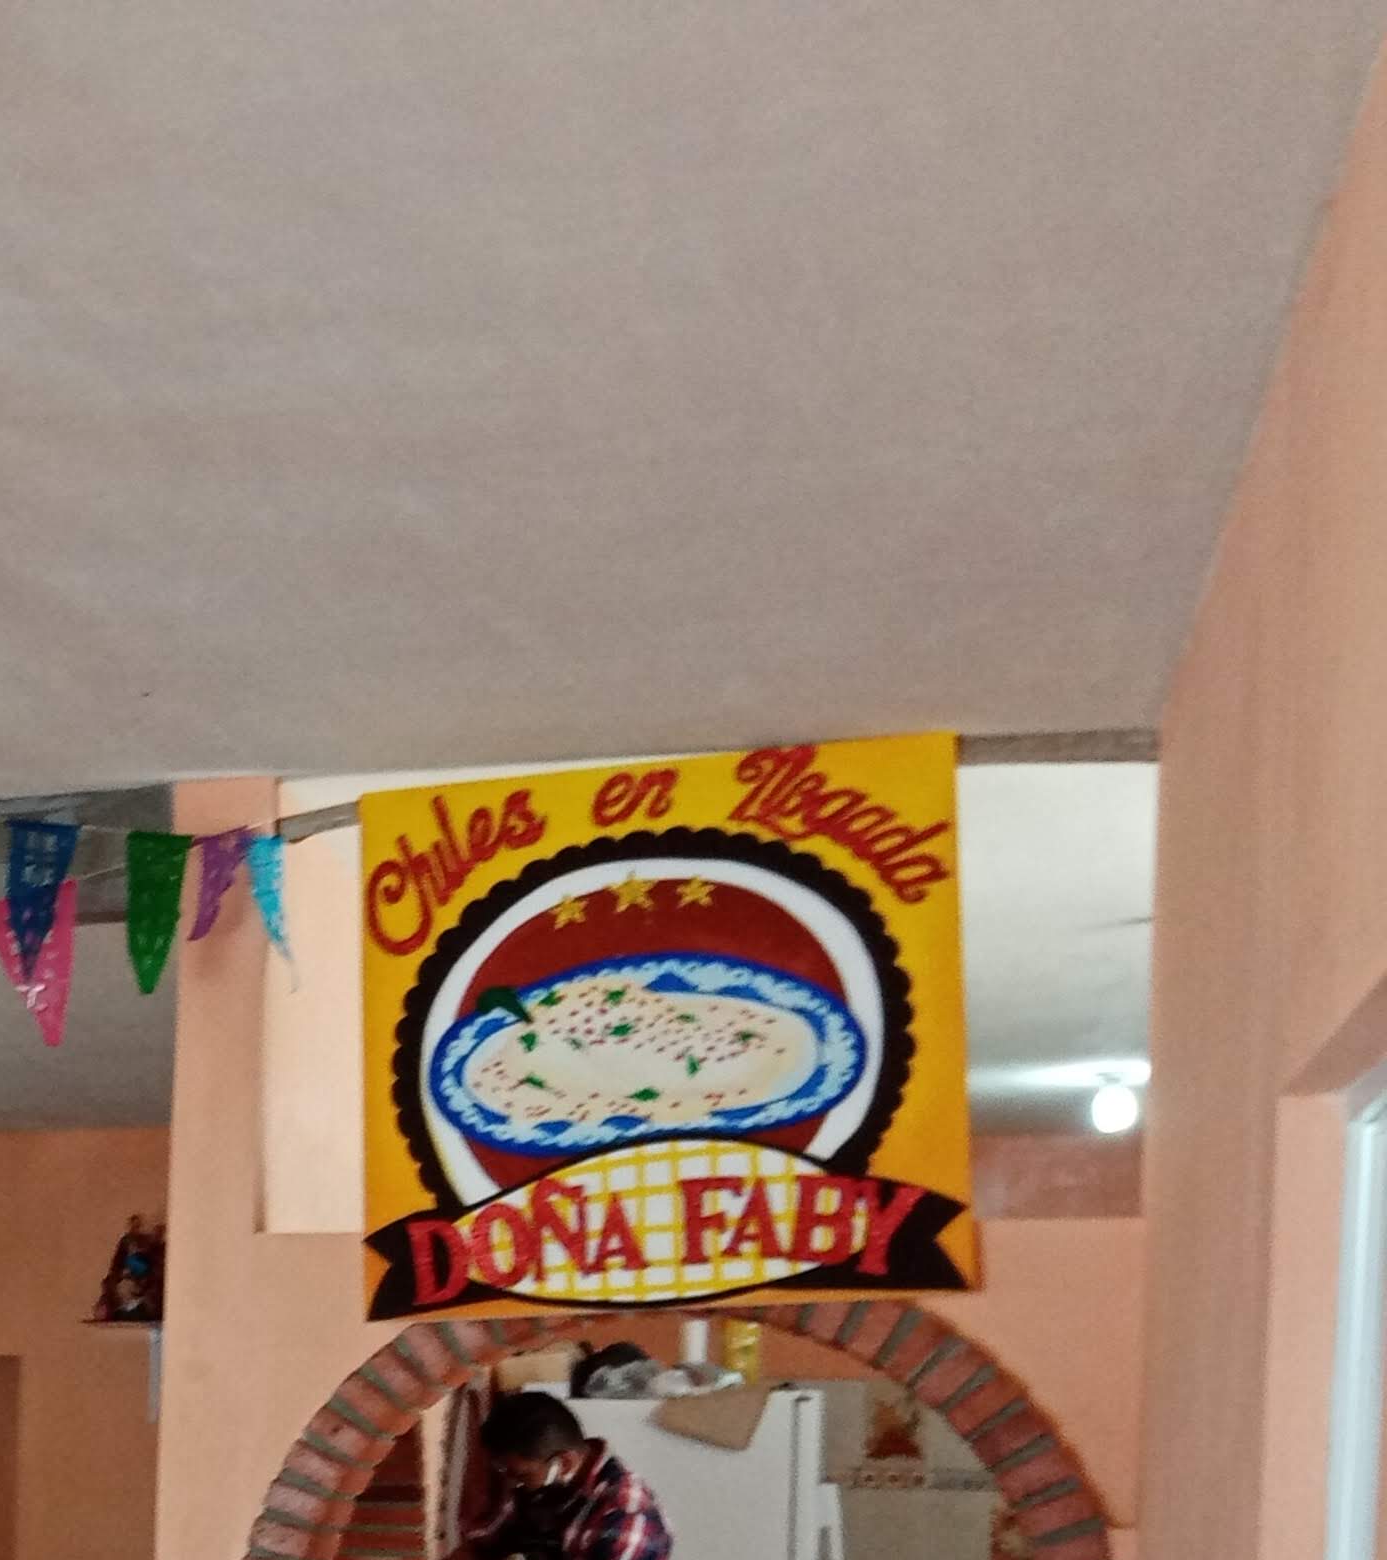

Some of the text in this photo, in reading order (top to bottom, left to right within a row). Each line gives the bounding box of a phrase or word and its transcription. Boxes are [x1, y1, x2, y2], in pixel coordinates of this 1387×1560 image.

[366, 742, 951, 957] Chiles en Nogada
[405, 1173, 929, 1306] DOÑA FABY
